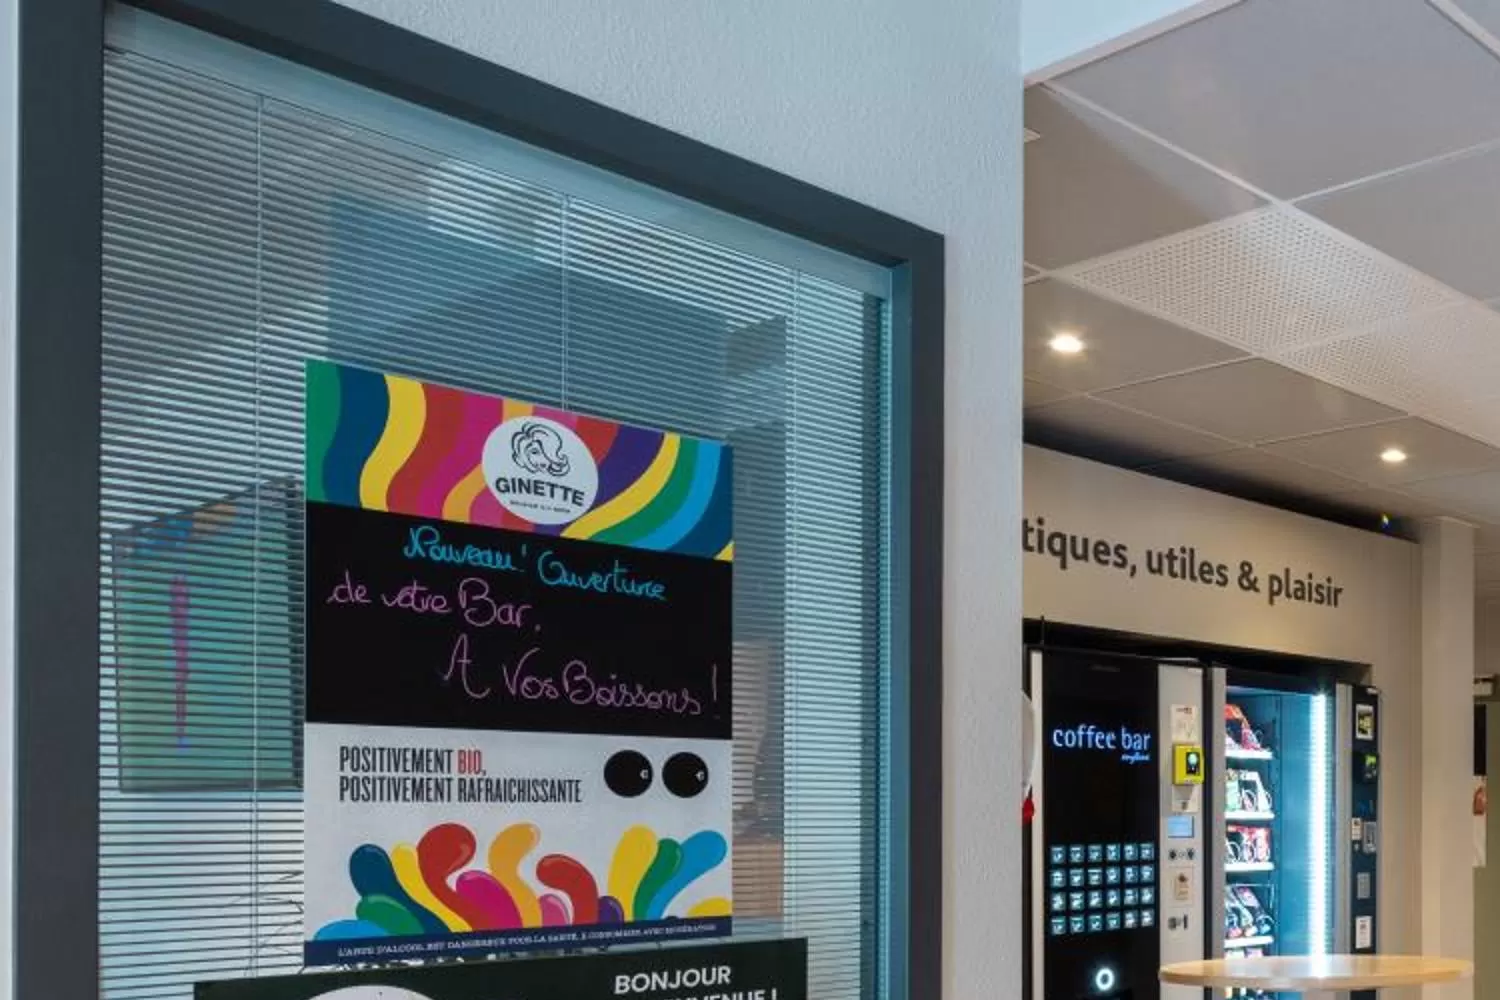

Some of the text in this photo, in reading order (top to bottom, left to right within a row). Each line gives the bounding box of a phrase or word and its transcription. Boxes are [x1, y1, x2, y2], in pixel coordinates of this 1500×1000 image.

[495, 477, 584, 506] GINETTE
[325, 568, 373, 603] de
[380, 579, 451, 613] votre
[537, 550, 668, 600] Ouverture
[1146, 547, 1229, 588] utiles
[1237, 560, 1261, 593] &
[1268, 567, 1345, 608] plaisir
[502, 647, 559, 699] Vos
[562, 659, 701, 714] Boissons
[1052, 724, 1151, 751] coffee bar
[339, 745, 487, 777] POSITIVEMENT BIO,
[339, 775, 583, 803] POSITIVEMENT RAFRAICHISSANTE
[614, 965, 731, 994] BONJOUR
